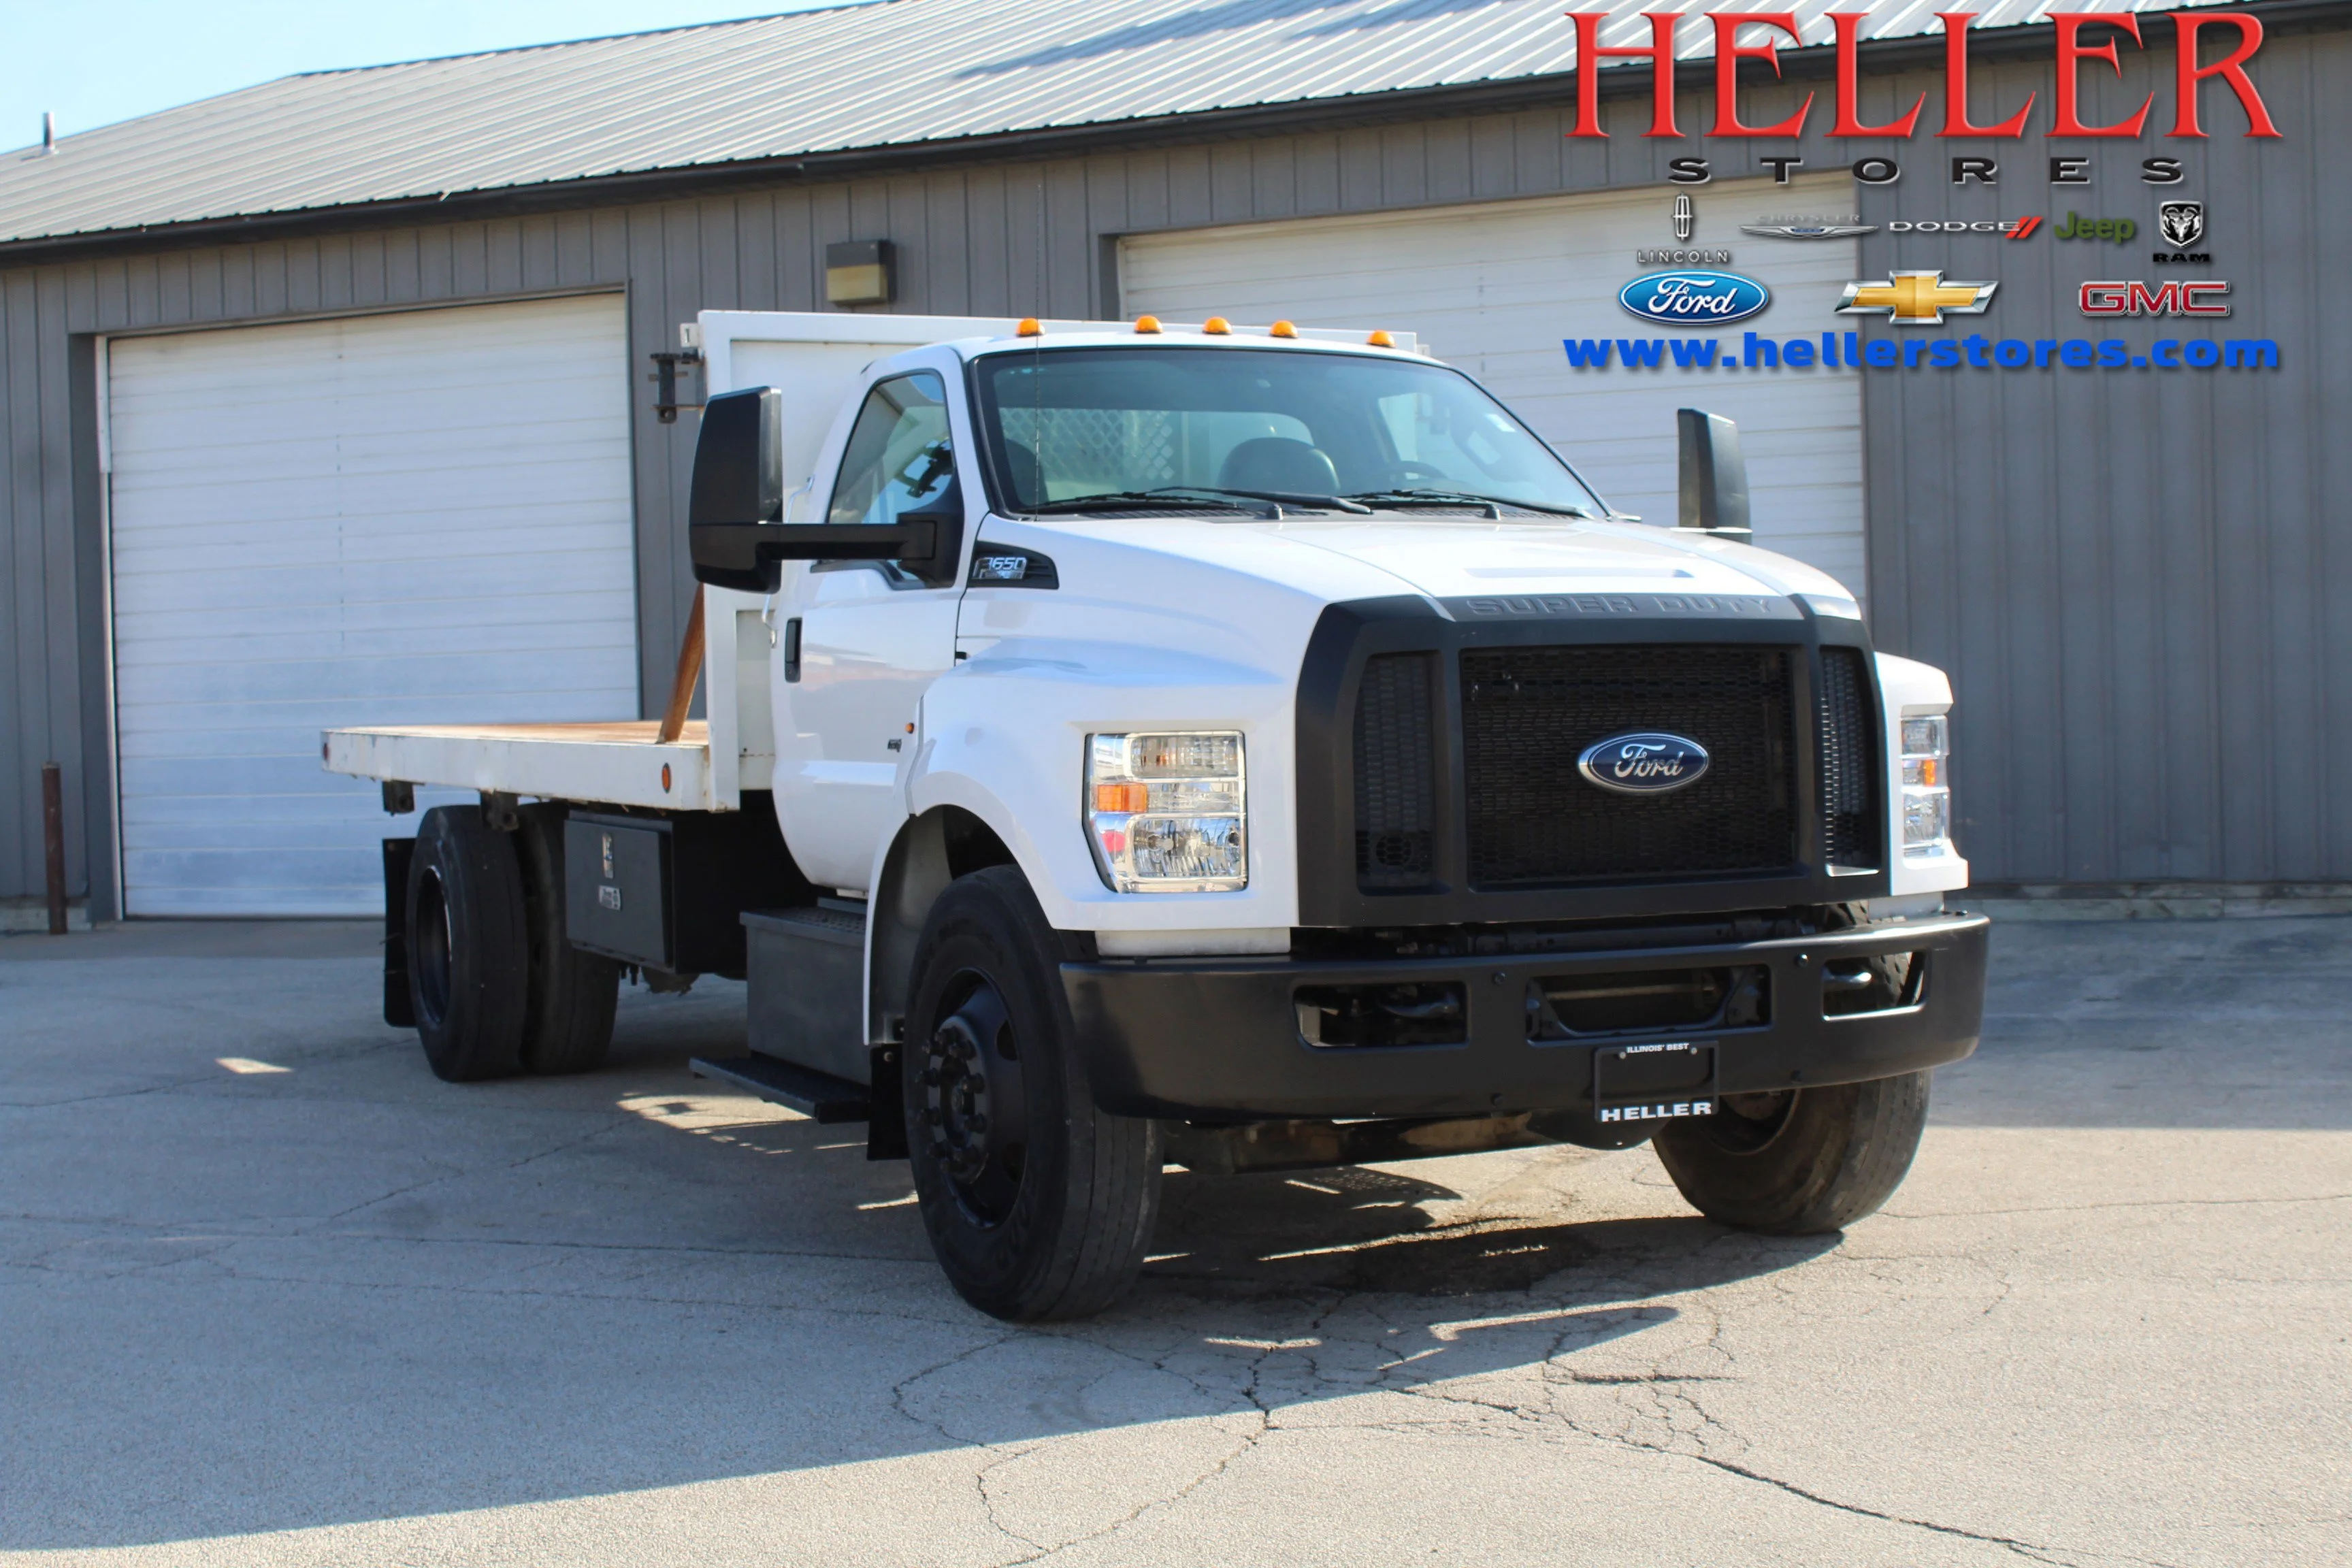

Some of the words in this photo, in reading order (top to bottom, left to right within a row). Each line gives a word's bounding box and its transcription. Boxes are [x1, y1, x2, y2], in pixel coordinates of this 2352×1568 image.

[1466, 595, 1638, 615] SUPER
[1652, 595, 1771, 614] DUTY
[1615, 743, 1684, 778] Ford
[1667, 1043, 1689, 1051] BEST
[1601, 1102, 1712, 1122] HELLER
